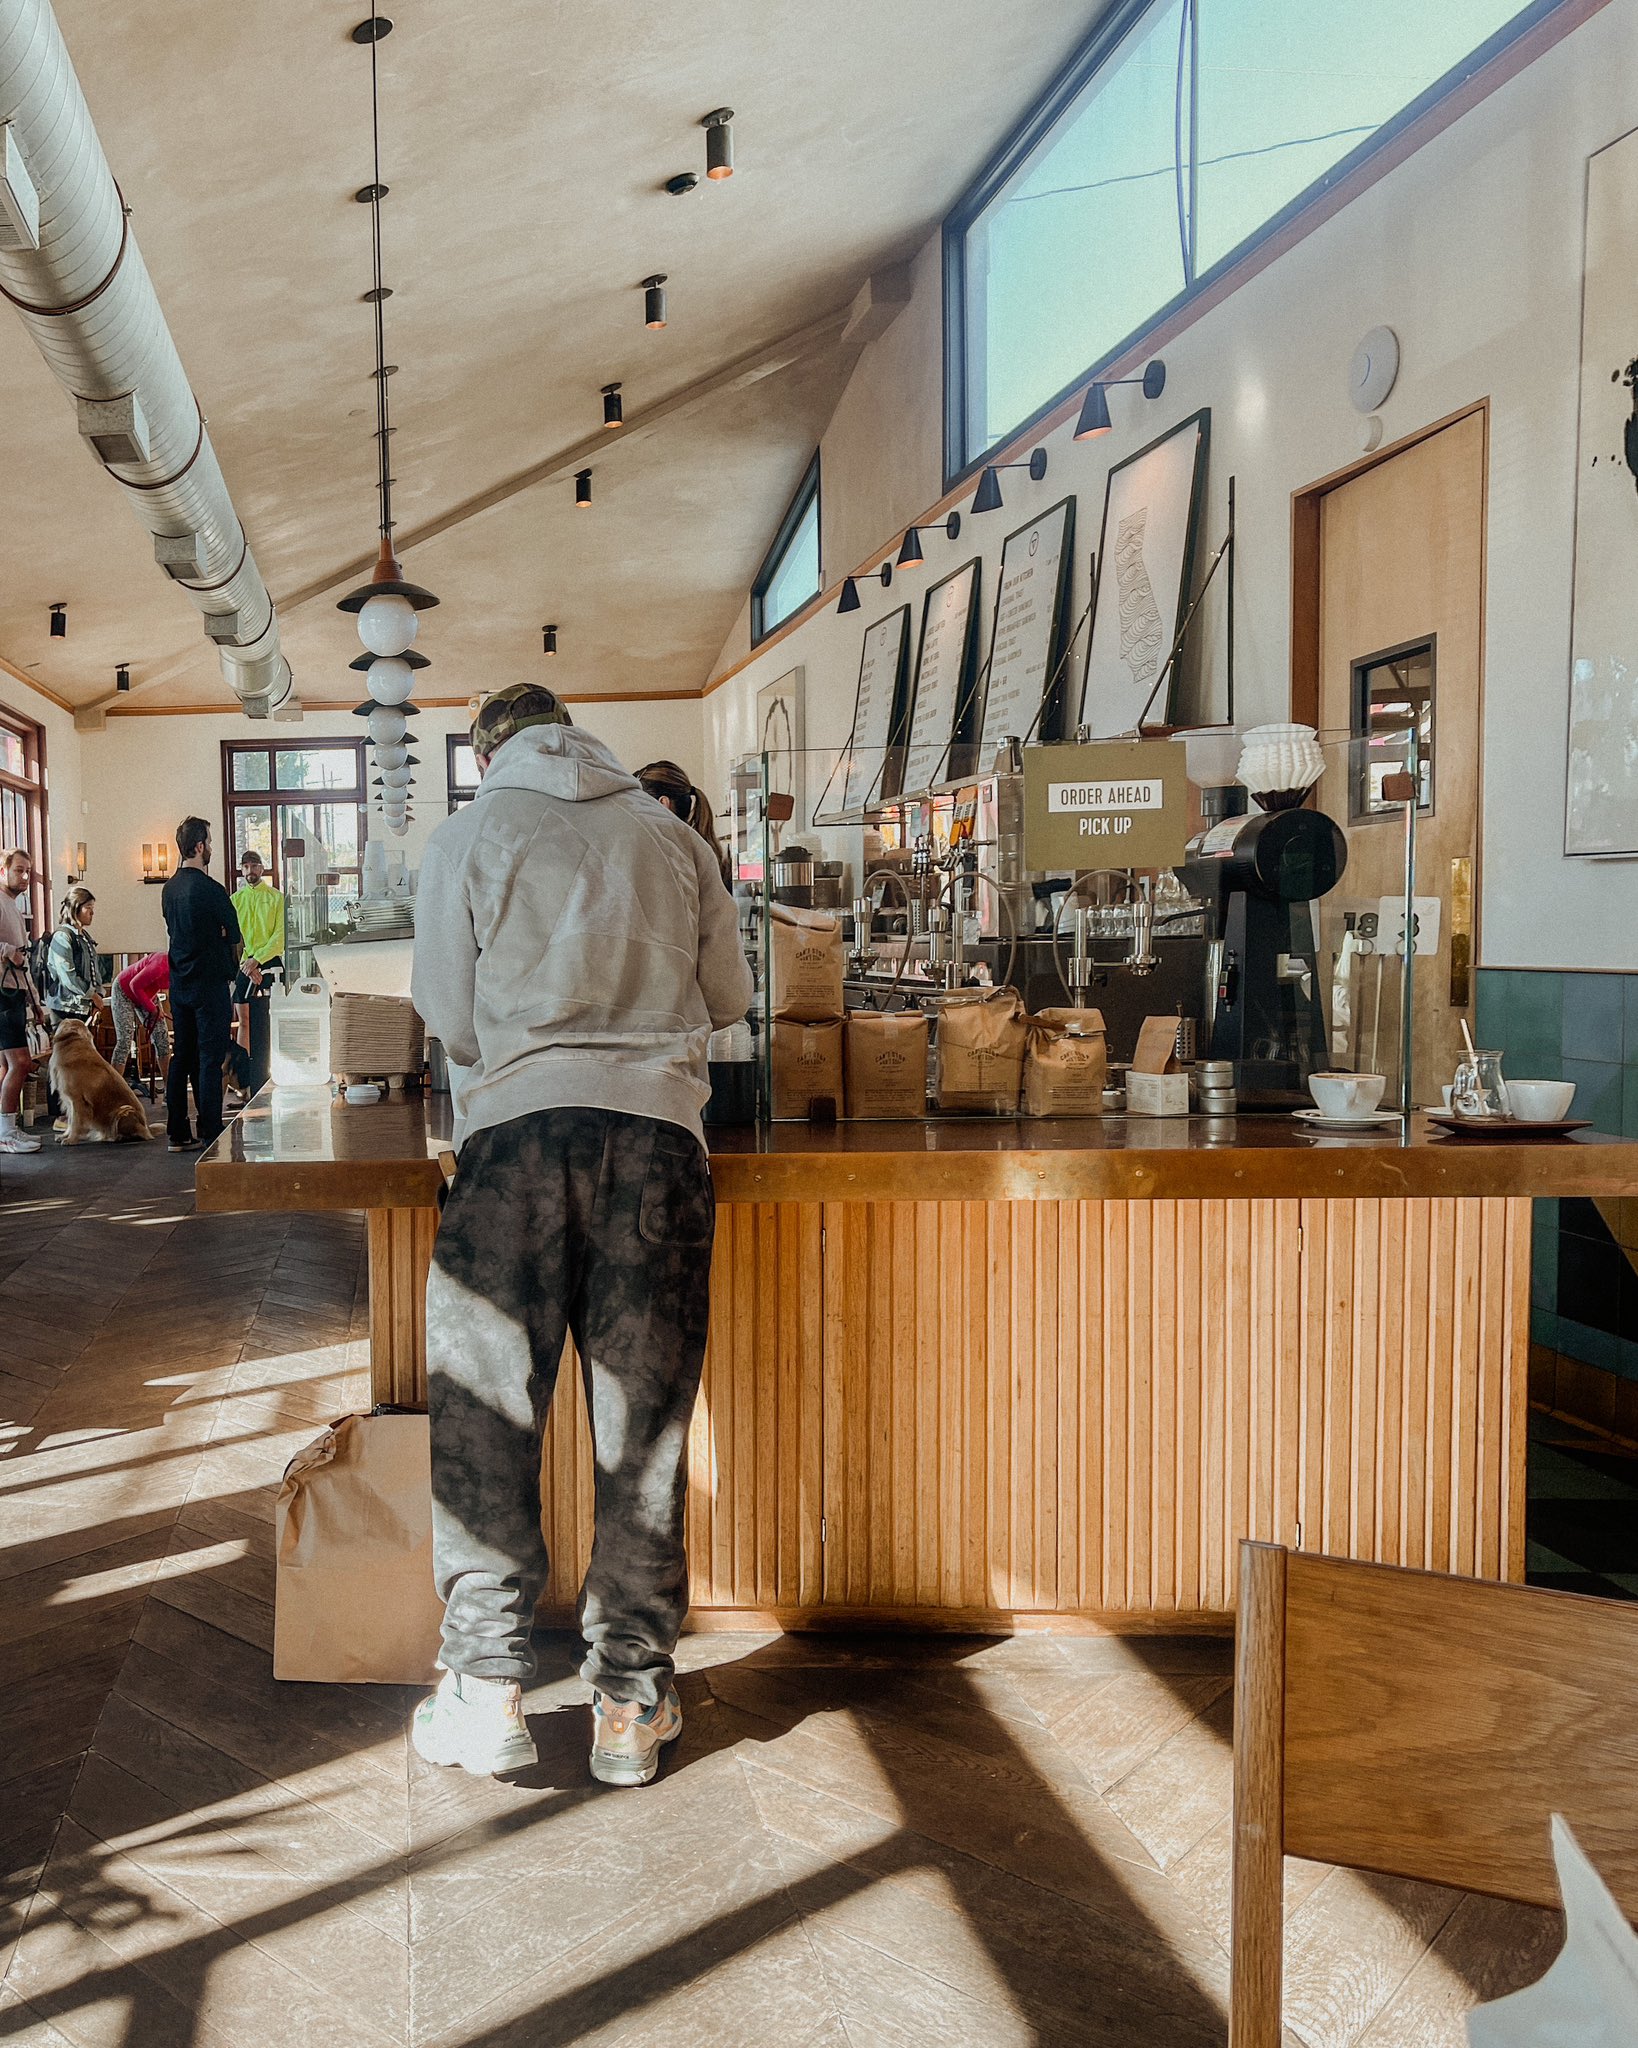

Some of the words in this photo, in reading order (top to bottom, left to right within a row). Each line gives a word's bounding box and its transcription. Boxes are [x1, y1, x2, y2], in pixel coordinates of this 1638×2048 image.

[1060, 788, 1103, 806] ORDER
[1108, 786, 1151, 804] AHEAD
[1079, 817, 1110, 836] PICK
[1113, 816, 1133, 835] UP
[1344, 912, 1379, 938] 18
